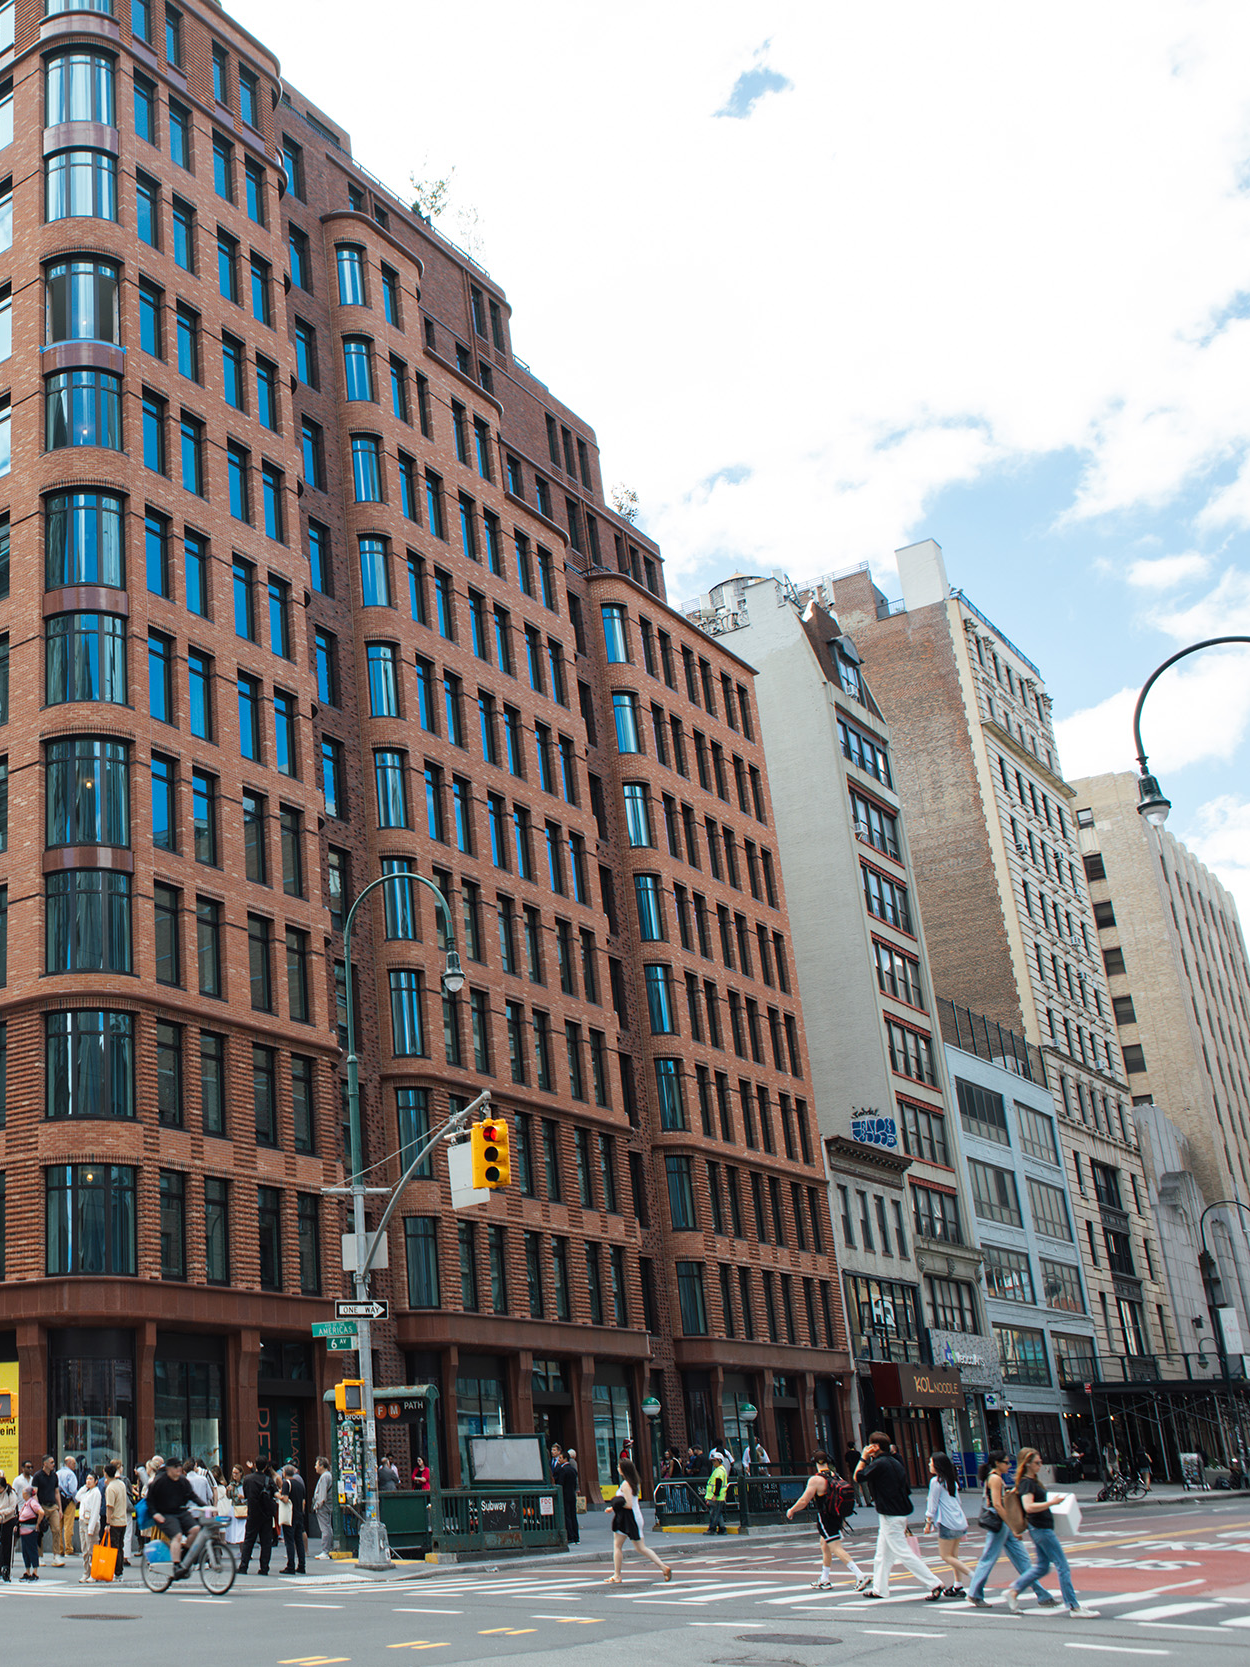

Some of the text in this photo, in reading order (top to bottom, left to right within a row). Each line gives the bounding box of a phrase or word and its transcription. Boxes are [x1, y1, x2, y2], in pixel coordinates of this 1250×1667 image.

[364, 1306, 380, 1314] WAY
[318, 1325, 353, 1336] AMERICAS
[331, 1338, 338, 1349] 6
[934, 1382, 959, 1395] NOODLE
[376, 1405, 399, 1416] F M
[403, 1401, 424, 1410] PATH
[5, 1425, 16, 1436] in!
[480, 1500, 507, 1512] Subway
